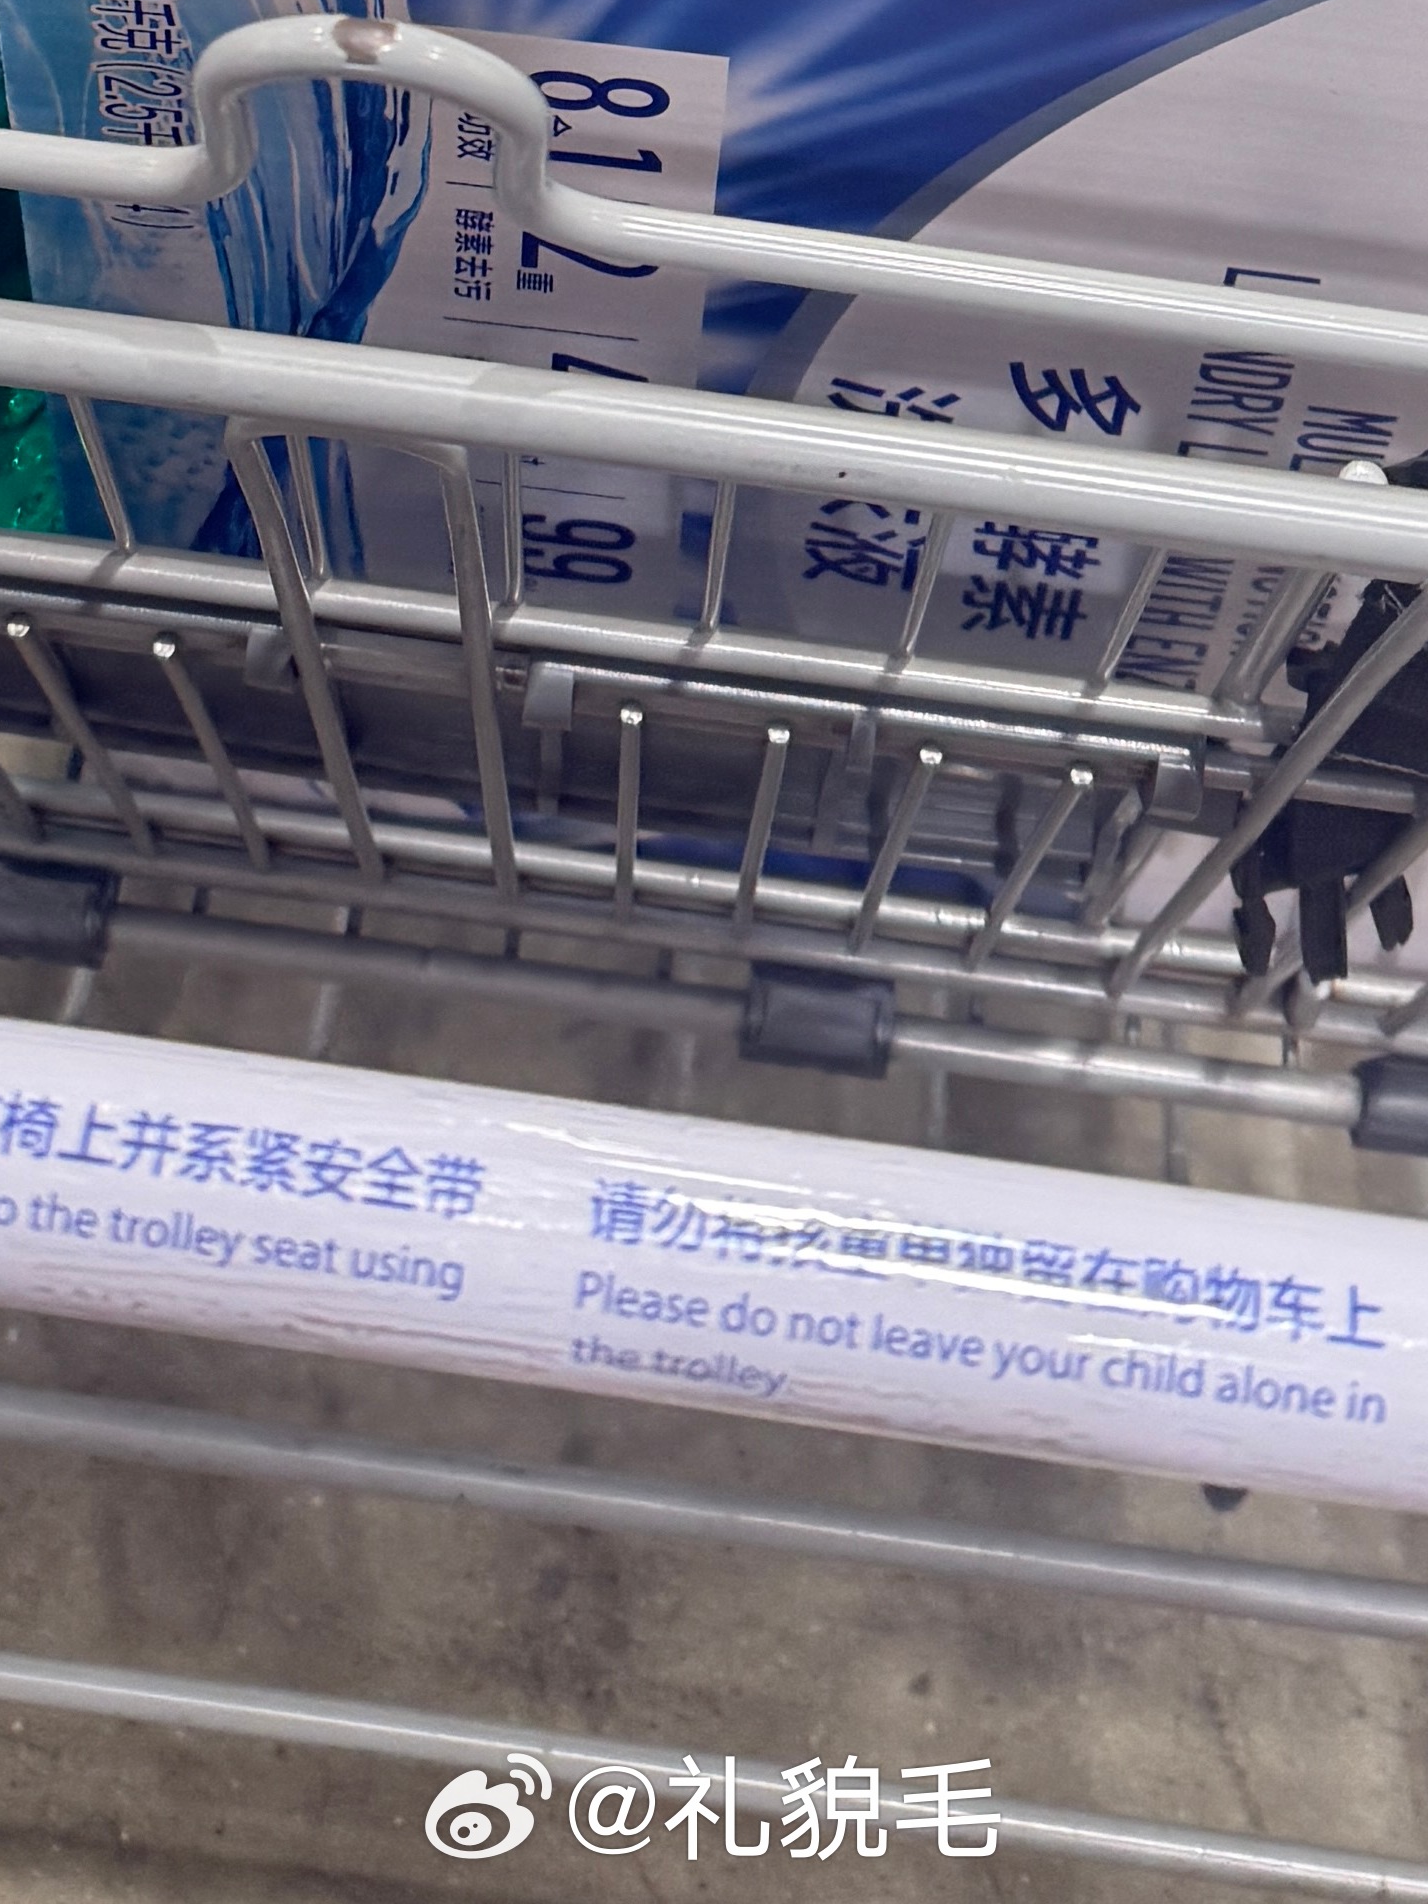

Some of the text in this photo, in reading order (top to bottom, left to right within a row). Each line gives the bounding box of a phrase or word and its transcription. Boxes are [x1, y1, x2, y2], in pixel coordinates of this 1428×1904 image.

[452, 206, 496, 304] 酵素去污
[26, 1189, 102, 1242] the
[108, 1196, 245, 1270] trolley
[248, 1222, 340, 1277] seat
[349, 1237, 468, 1304] using
[571, 1332, 646, 1372] the
[574, 1267, 1390, 1427] Please do not leave your child alone in
